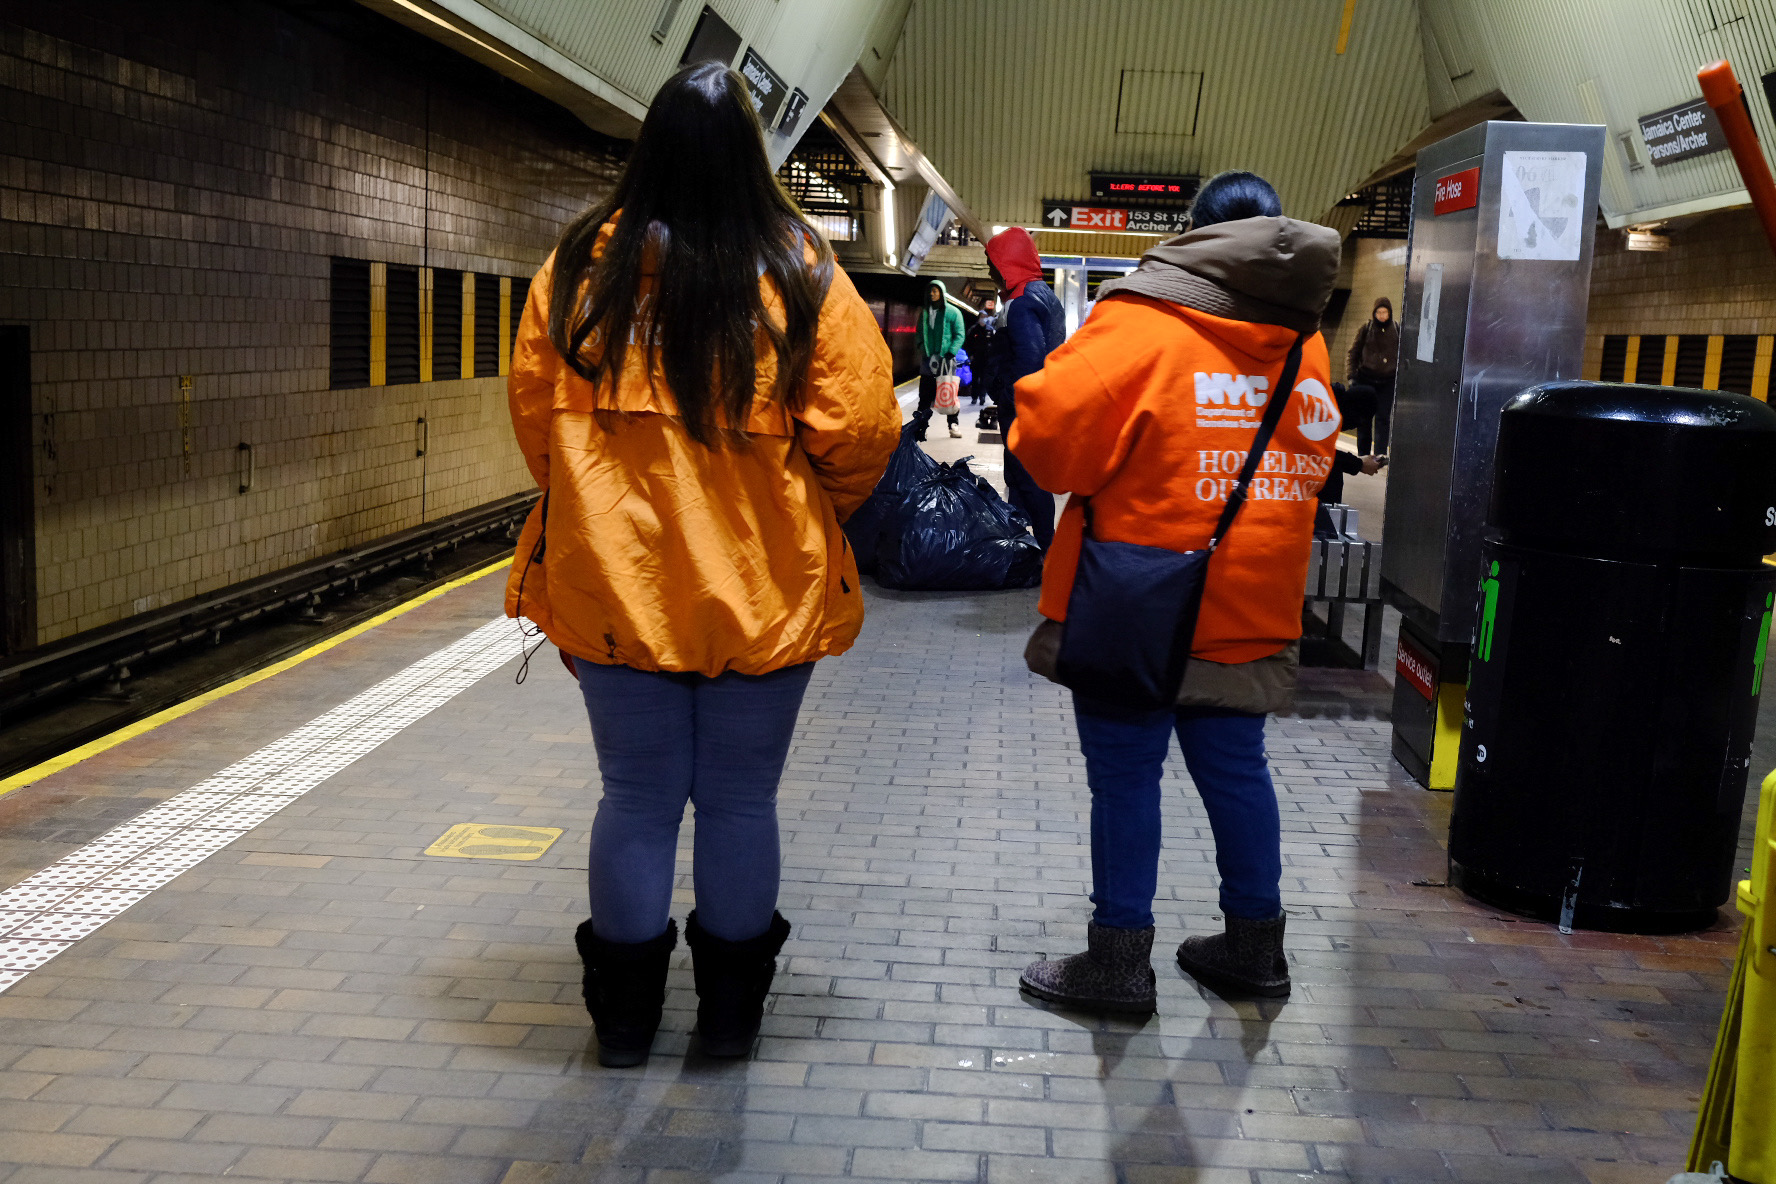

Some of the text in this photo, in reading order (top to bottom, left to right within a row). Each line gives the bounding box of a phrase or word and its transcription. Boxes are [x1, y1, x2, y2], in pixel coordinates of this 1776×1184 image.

[1642, 111, 1706, 141] Jamaica Center-
[1646, 131, 1708, 160] Parsons/Archer
[1138, 184, 1166, 192] BEFORE
[1435, 179, 1462, 203] Fire Hose
[1071, 207, 1123, 227] Exit
[1126, 220, 1171, 231] Archer
[1128, 211, 1189, 223] 153 St 15
[1194, 372, 1269, 407] NYC
[1195, 477, 1323, 502] OUREAC
[1397, 642, 1416, 674] Service
